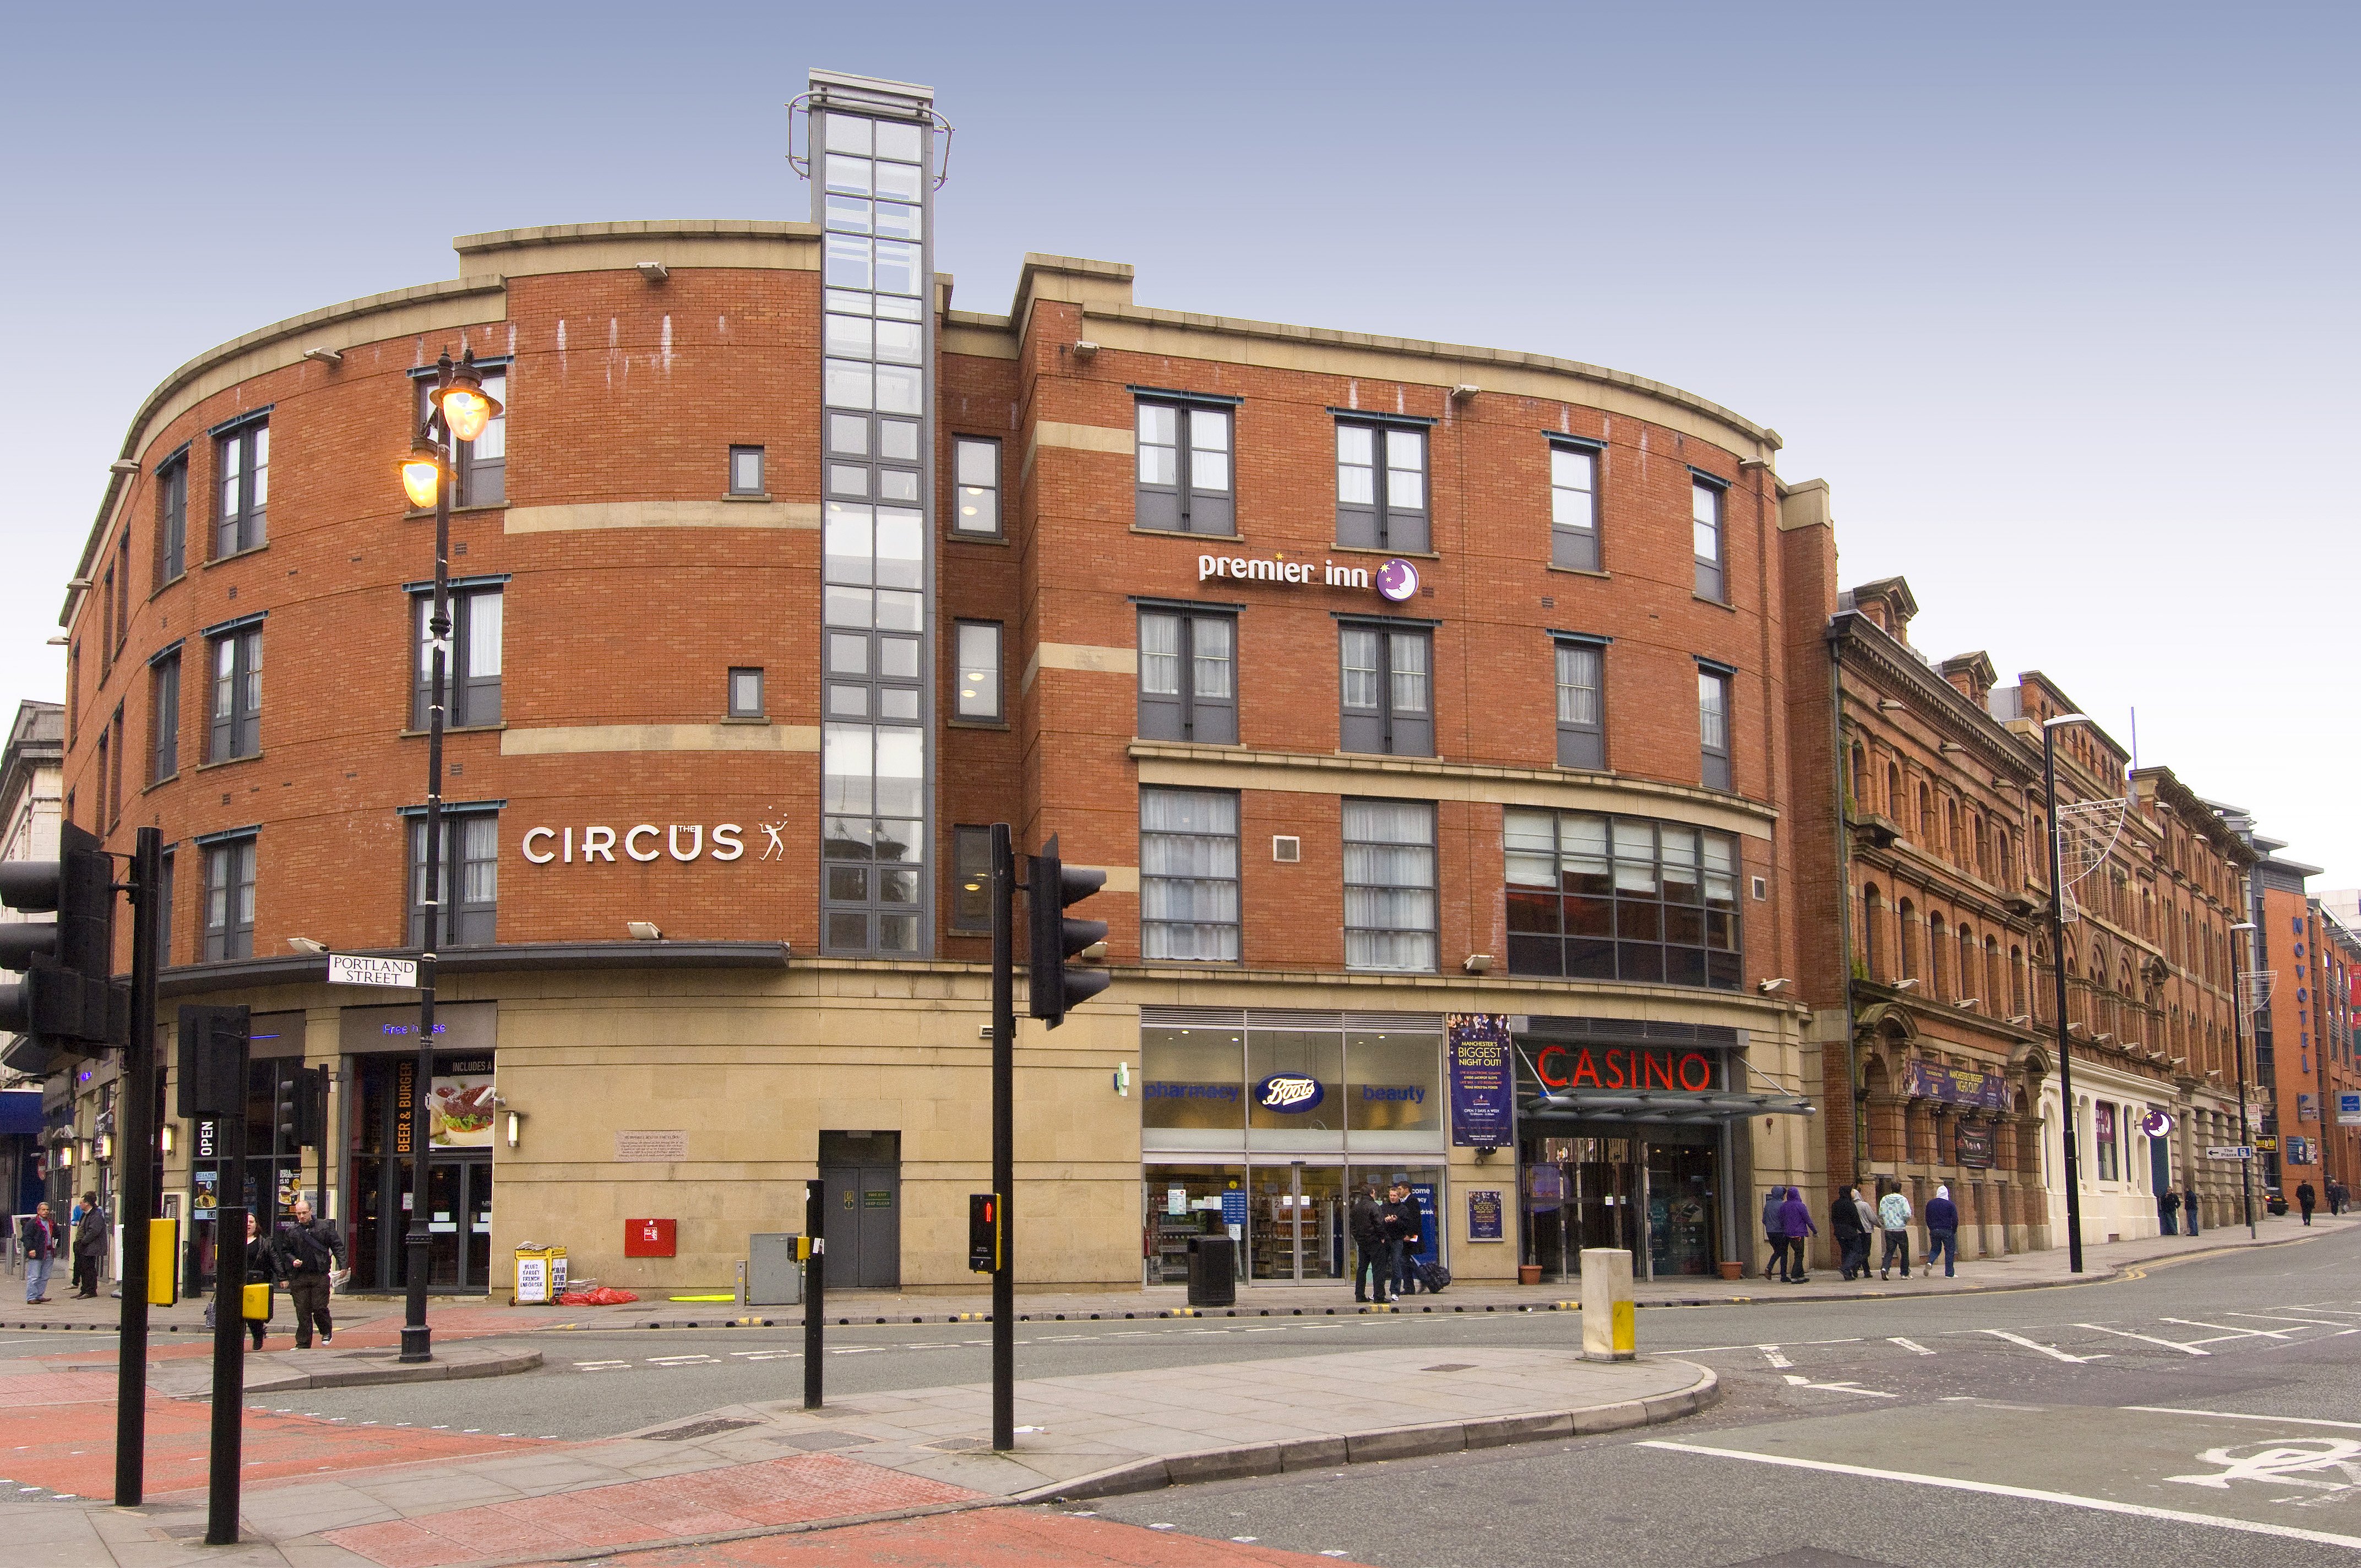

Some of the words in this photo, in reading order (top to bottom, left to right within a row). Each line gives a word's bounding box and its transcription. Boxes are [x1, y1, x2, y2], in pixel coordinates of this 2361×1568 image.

[1198, 553, 1315, 584] premier
[1325, 559, 1368, 587] inn
[522, 824, 744, 863] CIRCUS
[334, 957, 414, 973] PORTLAND
[346, 970, 401, 984] STREET
[2292, 916, 2311, 1072] NOVOTEL
[383, 1023, 408, 1035] Free
[412, 1023, 447, 1033] hse
[1458, 1047, 1502, 1058] BIGGEST
[453, 1061, 486, 1072] INCLUDES
[487, 1061, 492, 1070] A
[1538, 1046, 1710, 1092] CASINO
[399, 1063, 412, 1108] BURGER
[1145, 1081, 1239, 1103] pharmacy
[1262, 1078, 1315, 1106] Boots
[1363, 1084, 1426, 1104] beauty
[400, 1111, 411, 1120] &
[200, 1121, 213, 1156] OPEN
[398, 1124, 411, 1152] BEER
